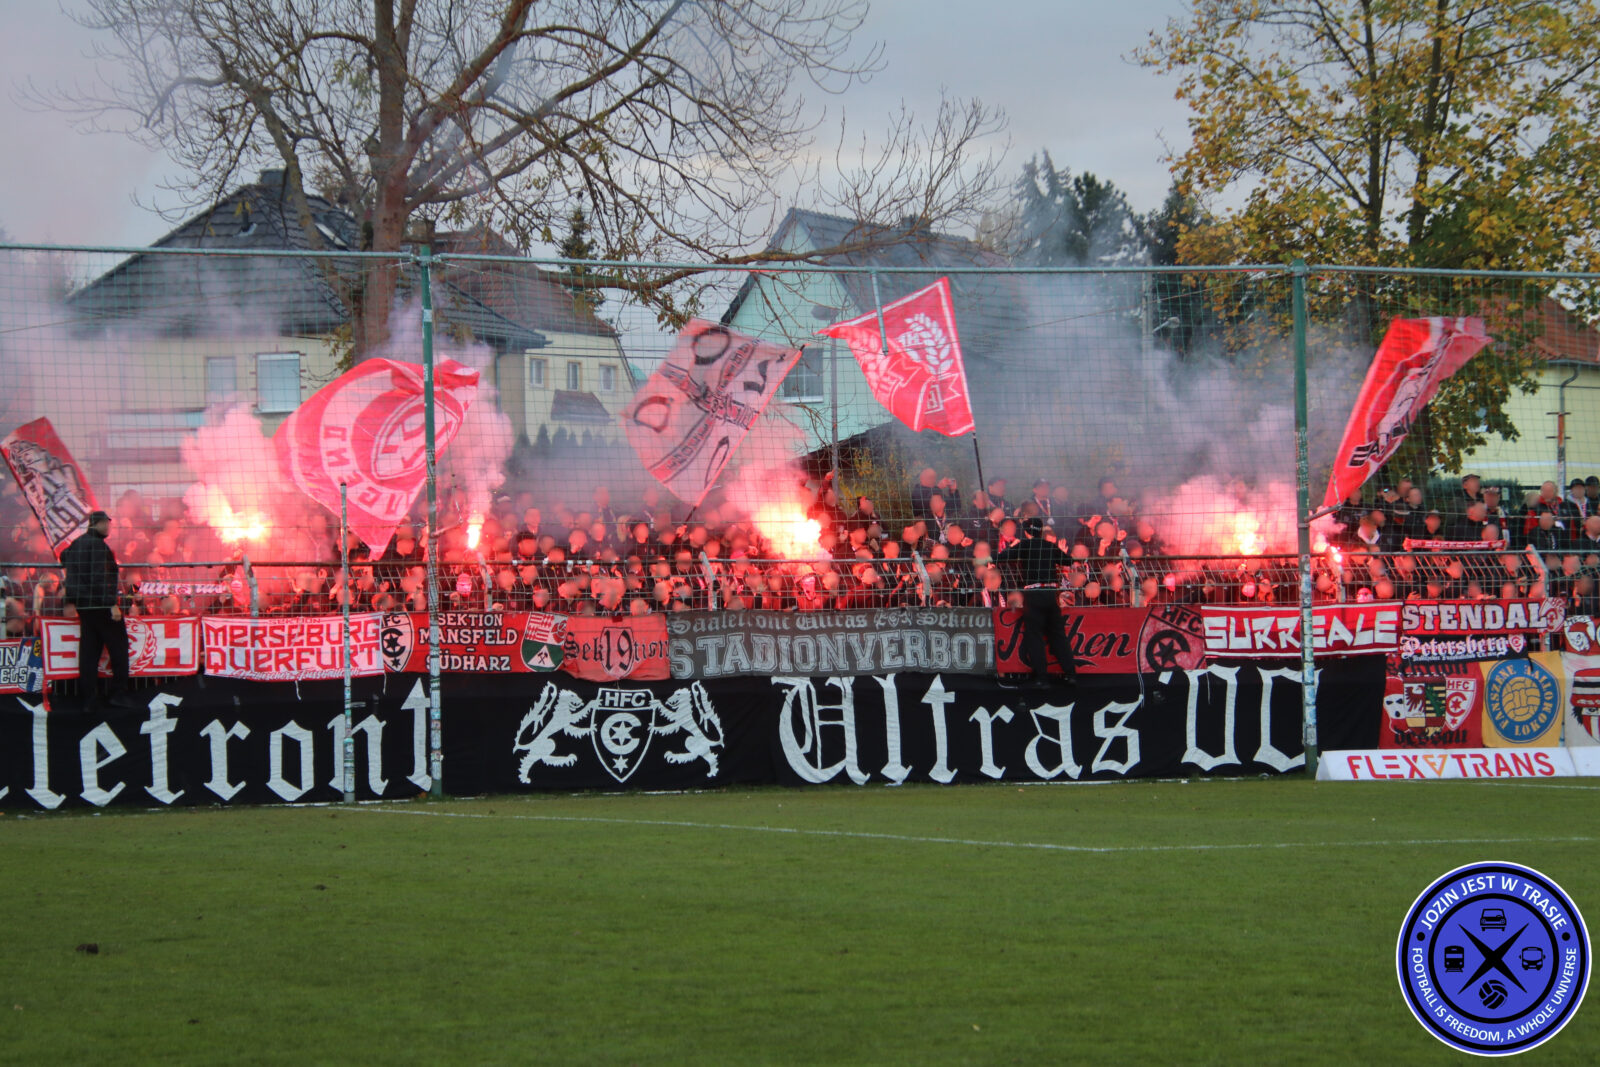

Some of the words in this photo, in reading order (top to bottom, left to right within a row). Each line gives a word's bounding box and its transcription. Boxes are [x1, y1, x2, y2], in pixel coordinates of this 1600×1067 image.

[267, 617, 312, 625] SEKTION
[439, 613, 503, 626] SEKTION
[1162, 605, 1202, 633] HFC
[1203, 611, 1398, 650] SURREALE
[1402, 603, 1548, 631] STENDAL
[152, 623, 193, 666] H
[669, 629, 996, 680] STADIONVERBOT
[1400, 634, 1508, 660] Petersberg
[1447, 680, 1470, 690] HFC
[605, 692, 646, 707] HFC
[771, 672, 1144, 787] Ultras
[1347, 754, 1426, 779] FLEX
[1449, 752, 1555, 777] TRANS
